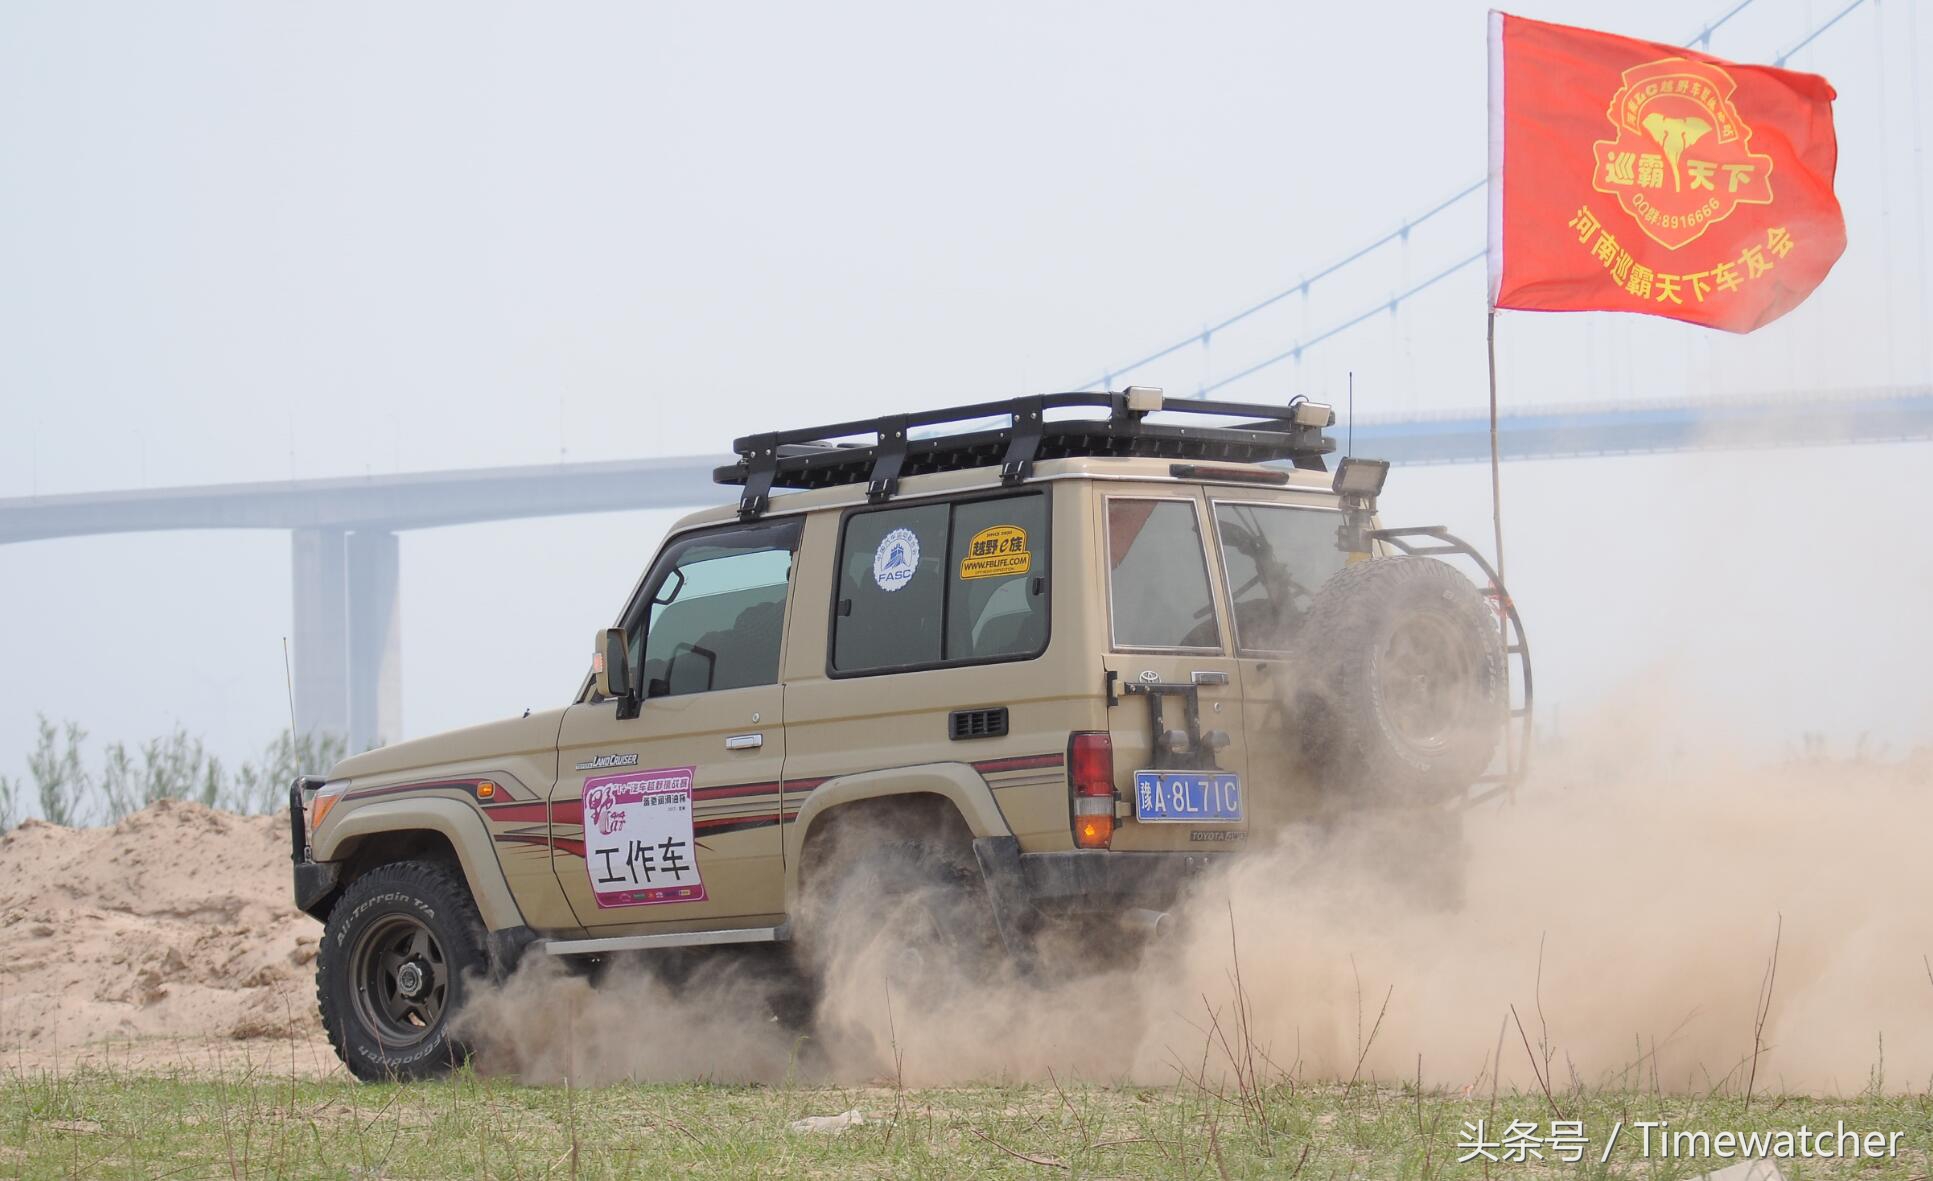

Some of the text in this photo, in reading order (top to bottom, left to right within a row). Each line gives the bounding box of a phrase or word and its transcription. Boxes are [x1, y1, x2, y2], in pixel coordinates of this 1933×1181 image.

[1605, 151, 1755, 193] 巡霸天下
[1568, 205, 1795, 305] 河南巡霸天下车友会
[878, 569, 912, 582] FASC
[964, 557, 1027, 571] WWW.FBLIFE.COM
[1191, 831, 1225, 841] TOYOTA
[595, 836, 690, 884] 工作车
[337, 891, 435, 947] All-Terrain T/A
